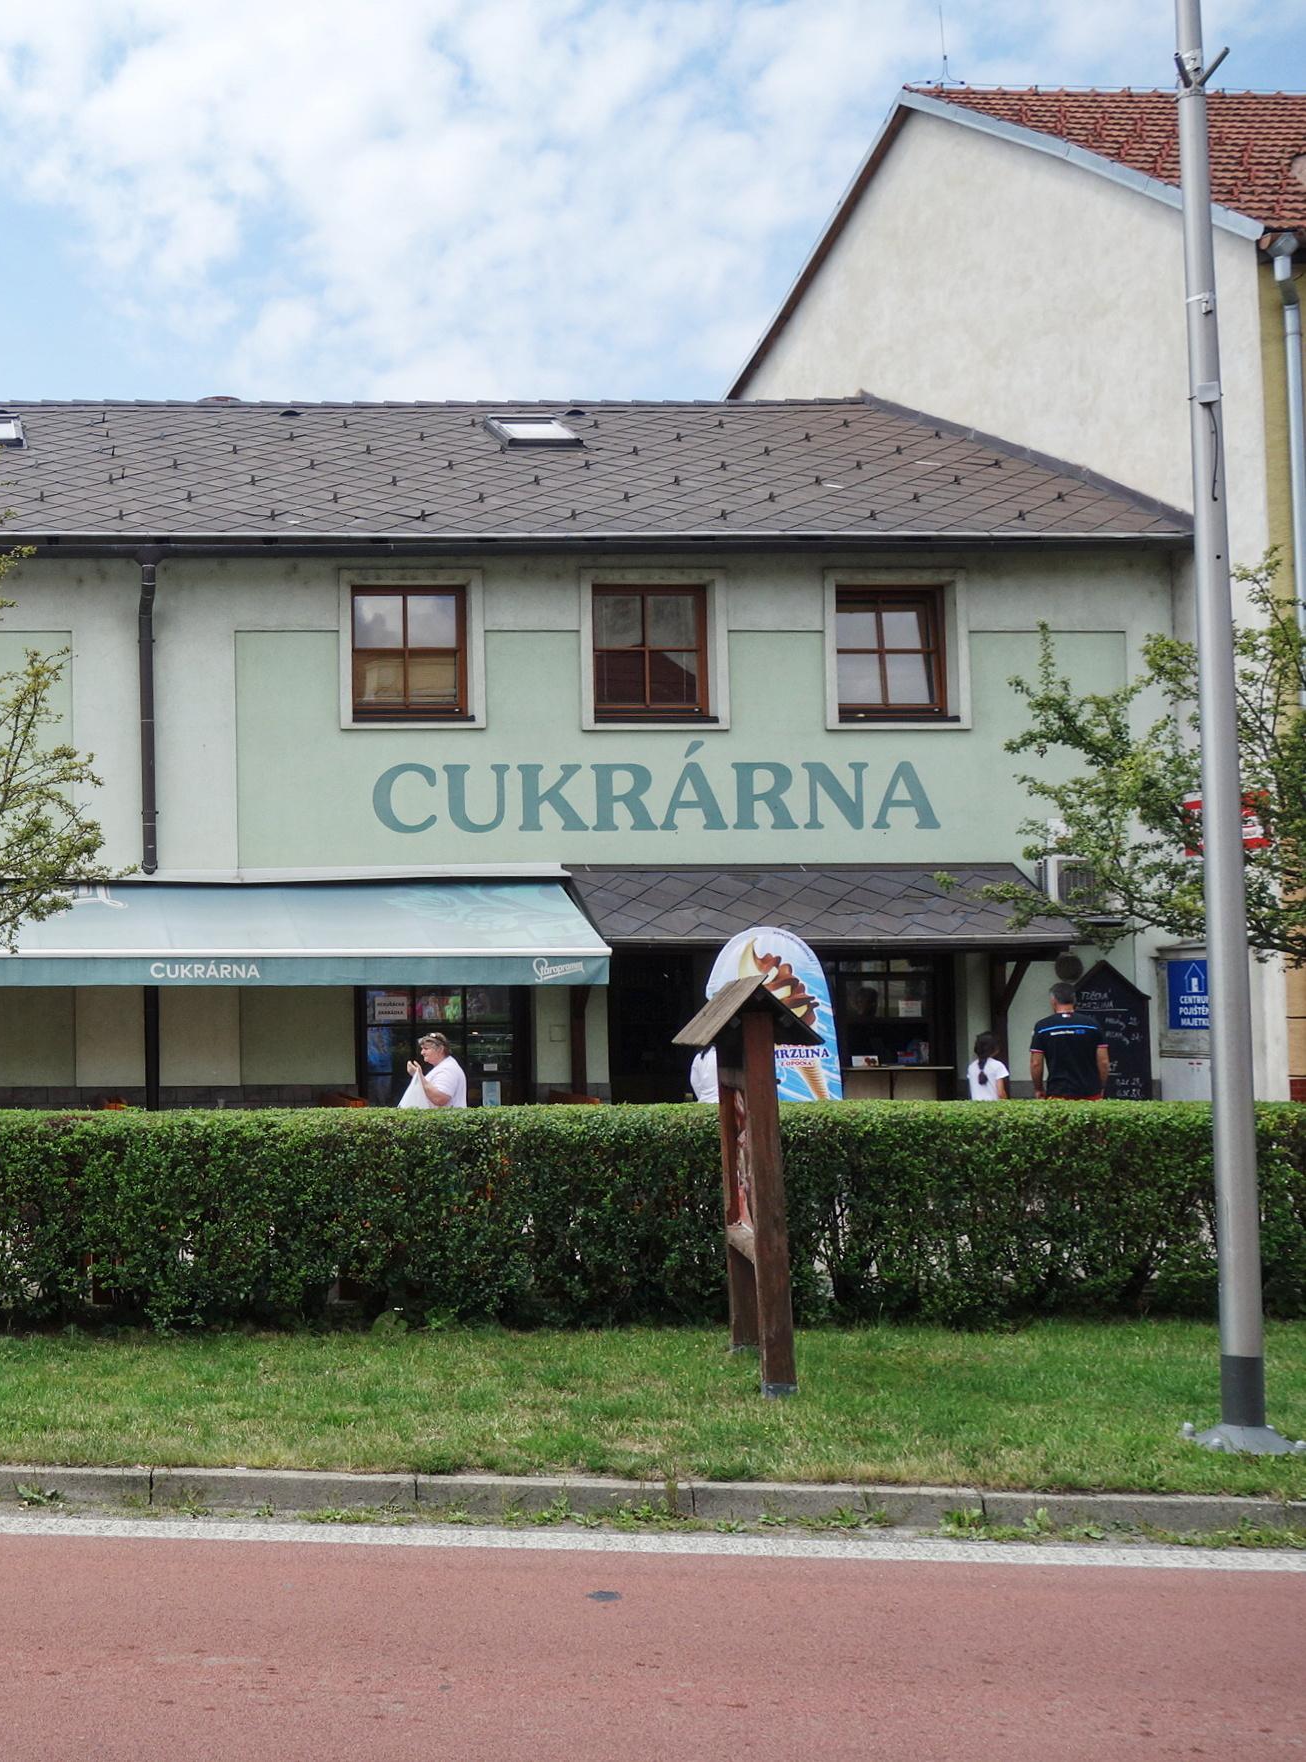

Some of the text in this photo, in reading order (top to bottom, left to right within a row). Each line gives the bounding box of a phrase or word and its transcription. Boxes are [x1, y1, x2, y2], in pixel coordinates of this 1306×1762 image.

[372, 740, 942, 833] CUKRÁRNA
[150, 960, 261, 979] CUKRÁRNA
[775, 1048, 830, 1059] MRZLINA
